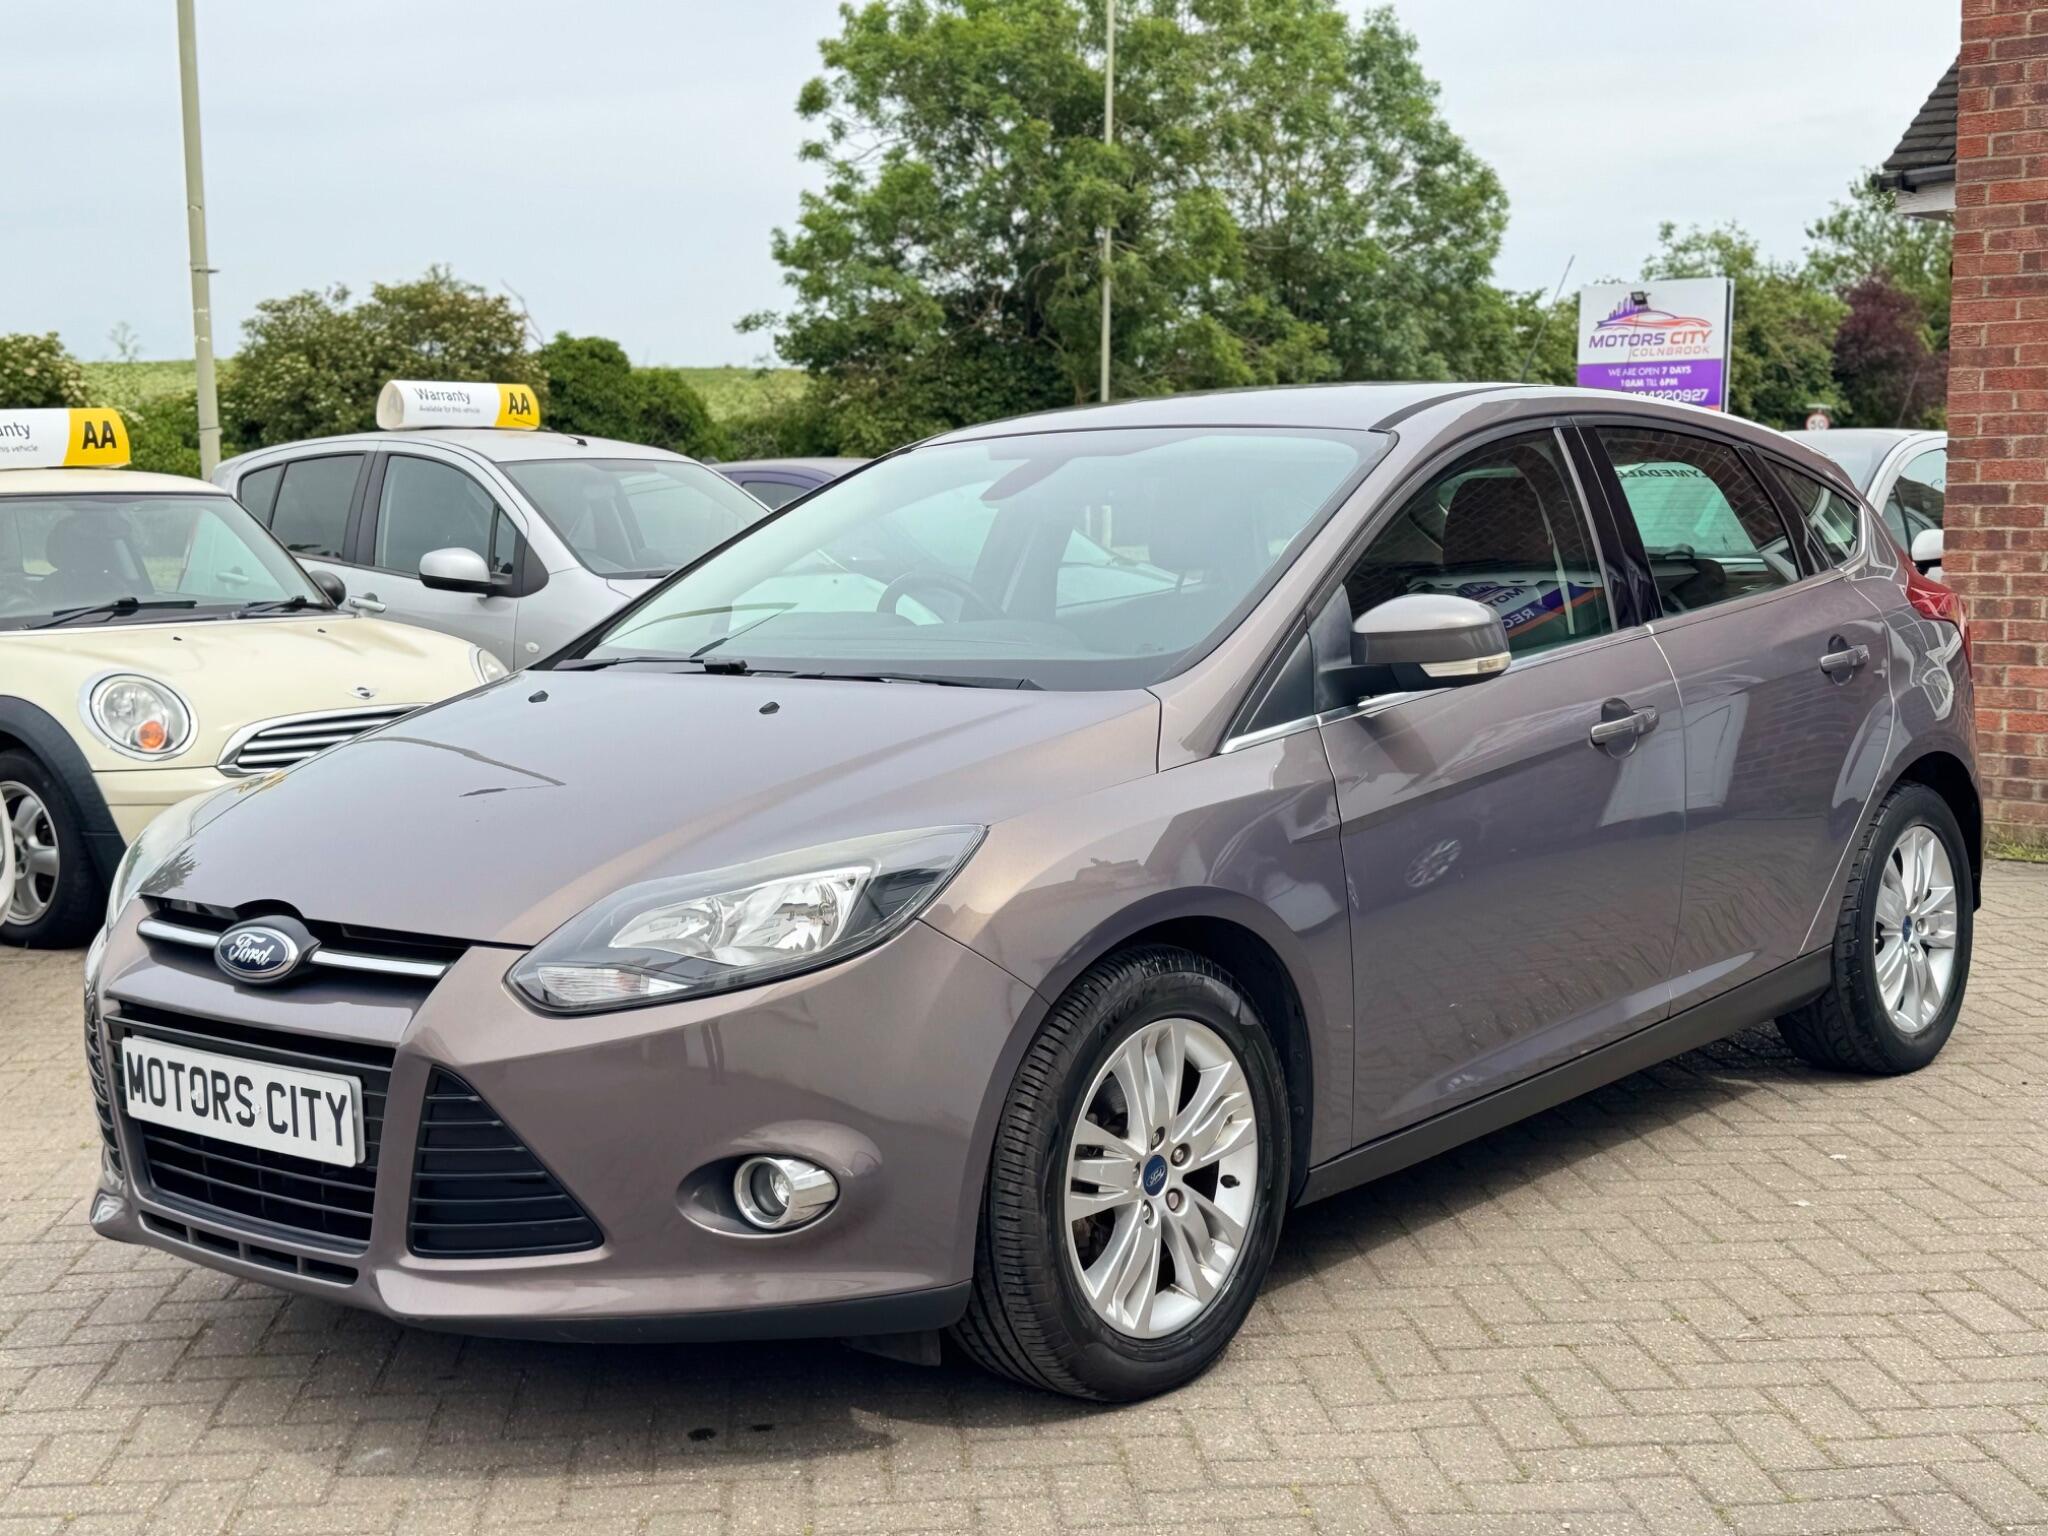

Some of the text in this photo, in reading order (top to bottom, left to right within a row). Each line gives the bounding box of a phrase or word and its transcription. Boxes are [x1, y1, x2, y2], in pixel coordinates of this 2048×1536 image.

[1588, 330, 1712, 348] MOTORS CITY
[1632, 346, 1710, 357] COLNBROOK
[1608, 365, 1692, 377] WE ARE OPEN 7 DAYS
[1659, 377, 1679, 386] 6PM
[414, 388, 471, 405] Warranty
[508, 392, 531, 416] AA
[82, 421, 117, 450] AA
[228, 933, 275, 966] Ford
[126, 1051, 348, 1147] MOTORS CITY
